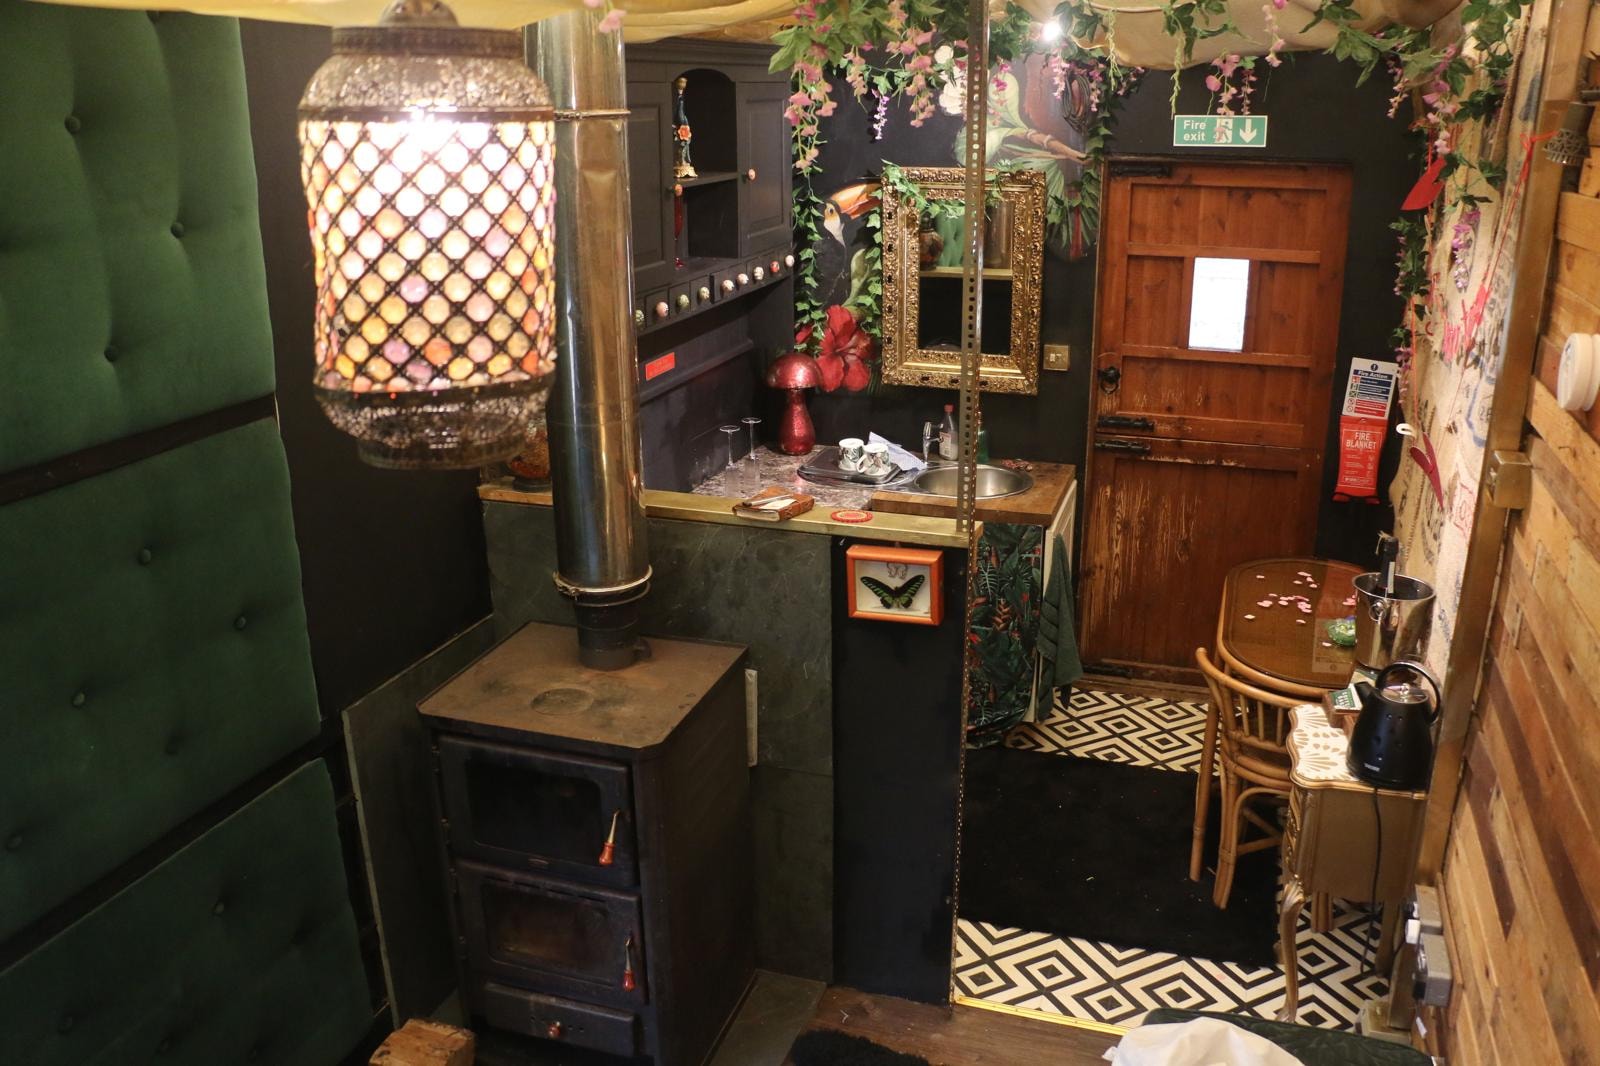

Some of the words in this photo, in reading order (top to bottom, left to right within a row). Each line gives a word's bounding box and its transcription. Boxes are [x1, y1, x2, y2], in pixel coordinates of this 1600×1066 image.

[1183, 120, 1207, 130] Fire
[1183, 132, 1206, 141] exit
[1354, 432, 1371, 441] FIRE
[1345, 440, 1377, 450] BLANKET
